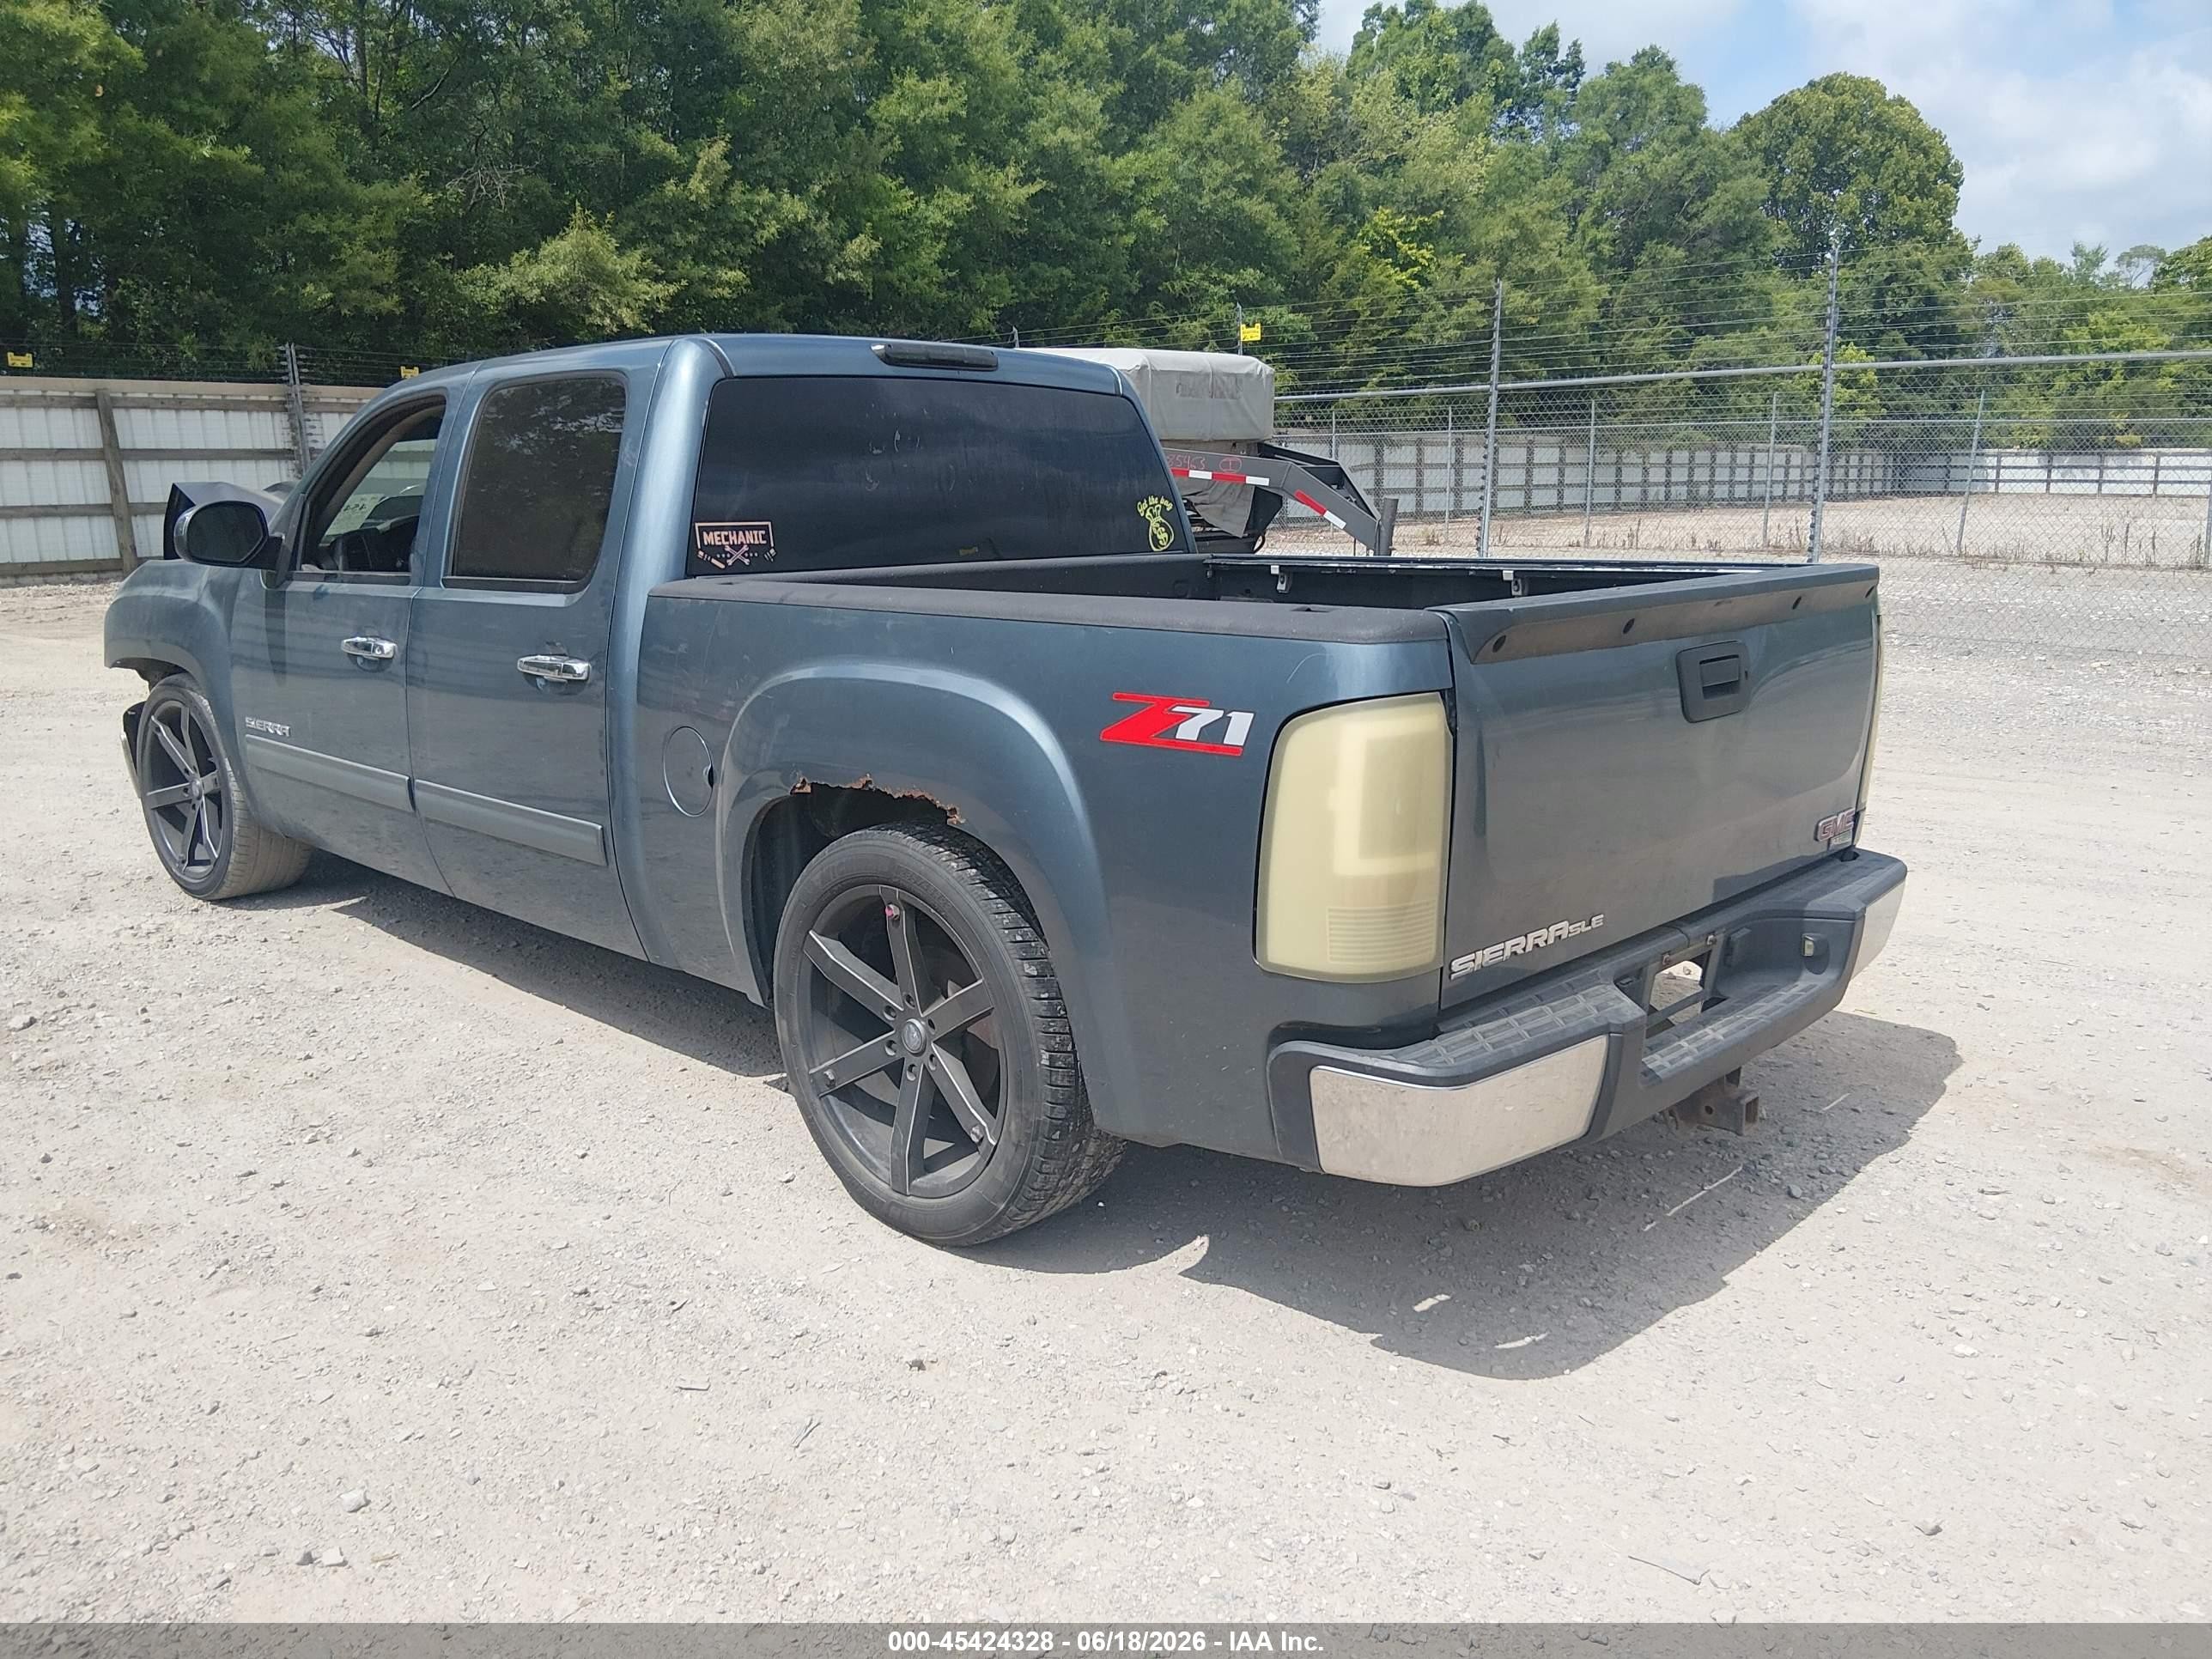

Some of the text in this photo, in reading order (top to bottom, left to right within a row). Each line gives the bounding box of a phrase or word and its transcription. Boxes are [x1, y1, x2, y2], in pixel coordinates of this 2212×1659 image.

[1149, 495, 1158, 505] the
[1160, 495, 1173, 511] bag
[702, 530, 767, 545] MECHANIC
[245, 716, 290, 737] SIERRA
[1100, 692, 1255, 756] Z71
[1818, 807, 1855, 841] GMC
[1450, 914, 1604, 980] SIERRA SLE
